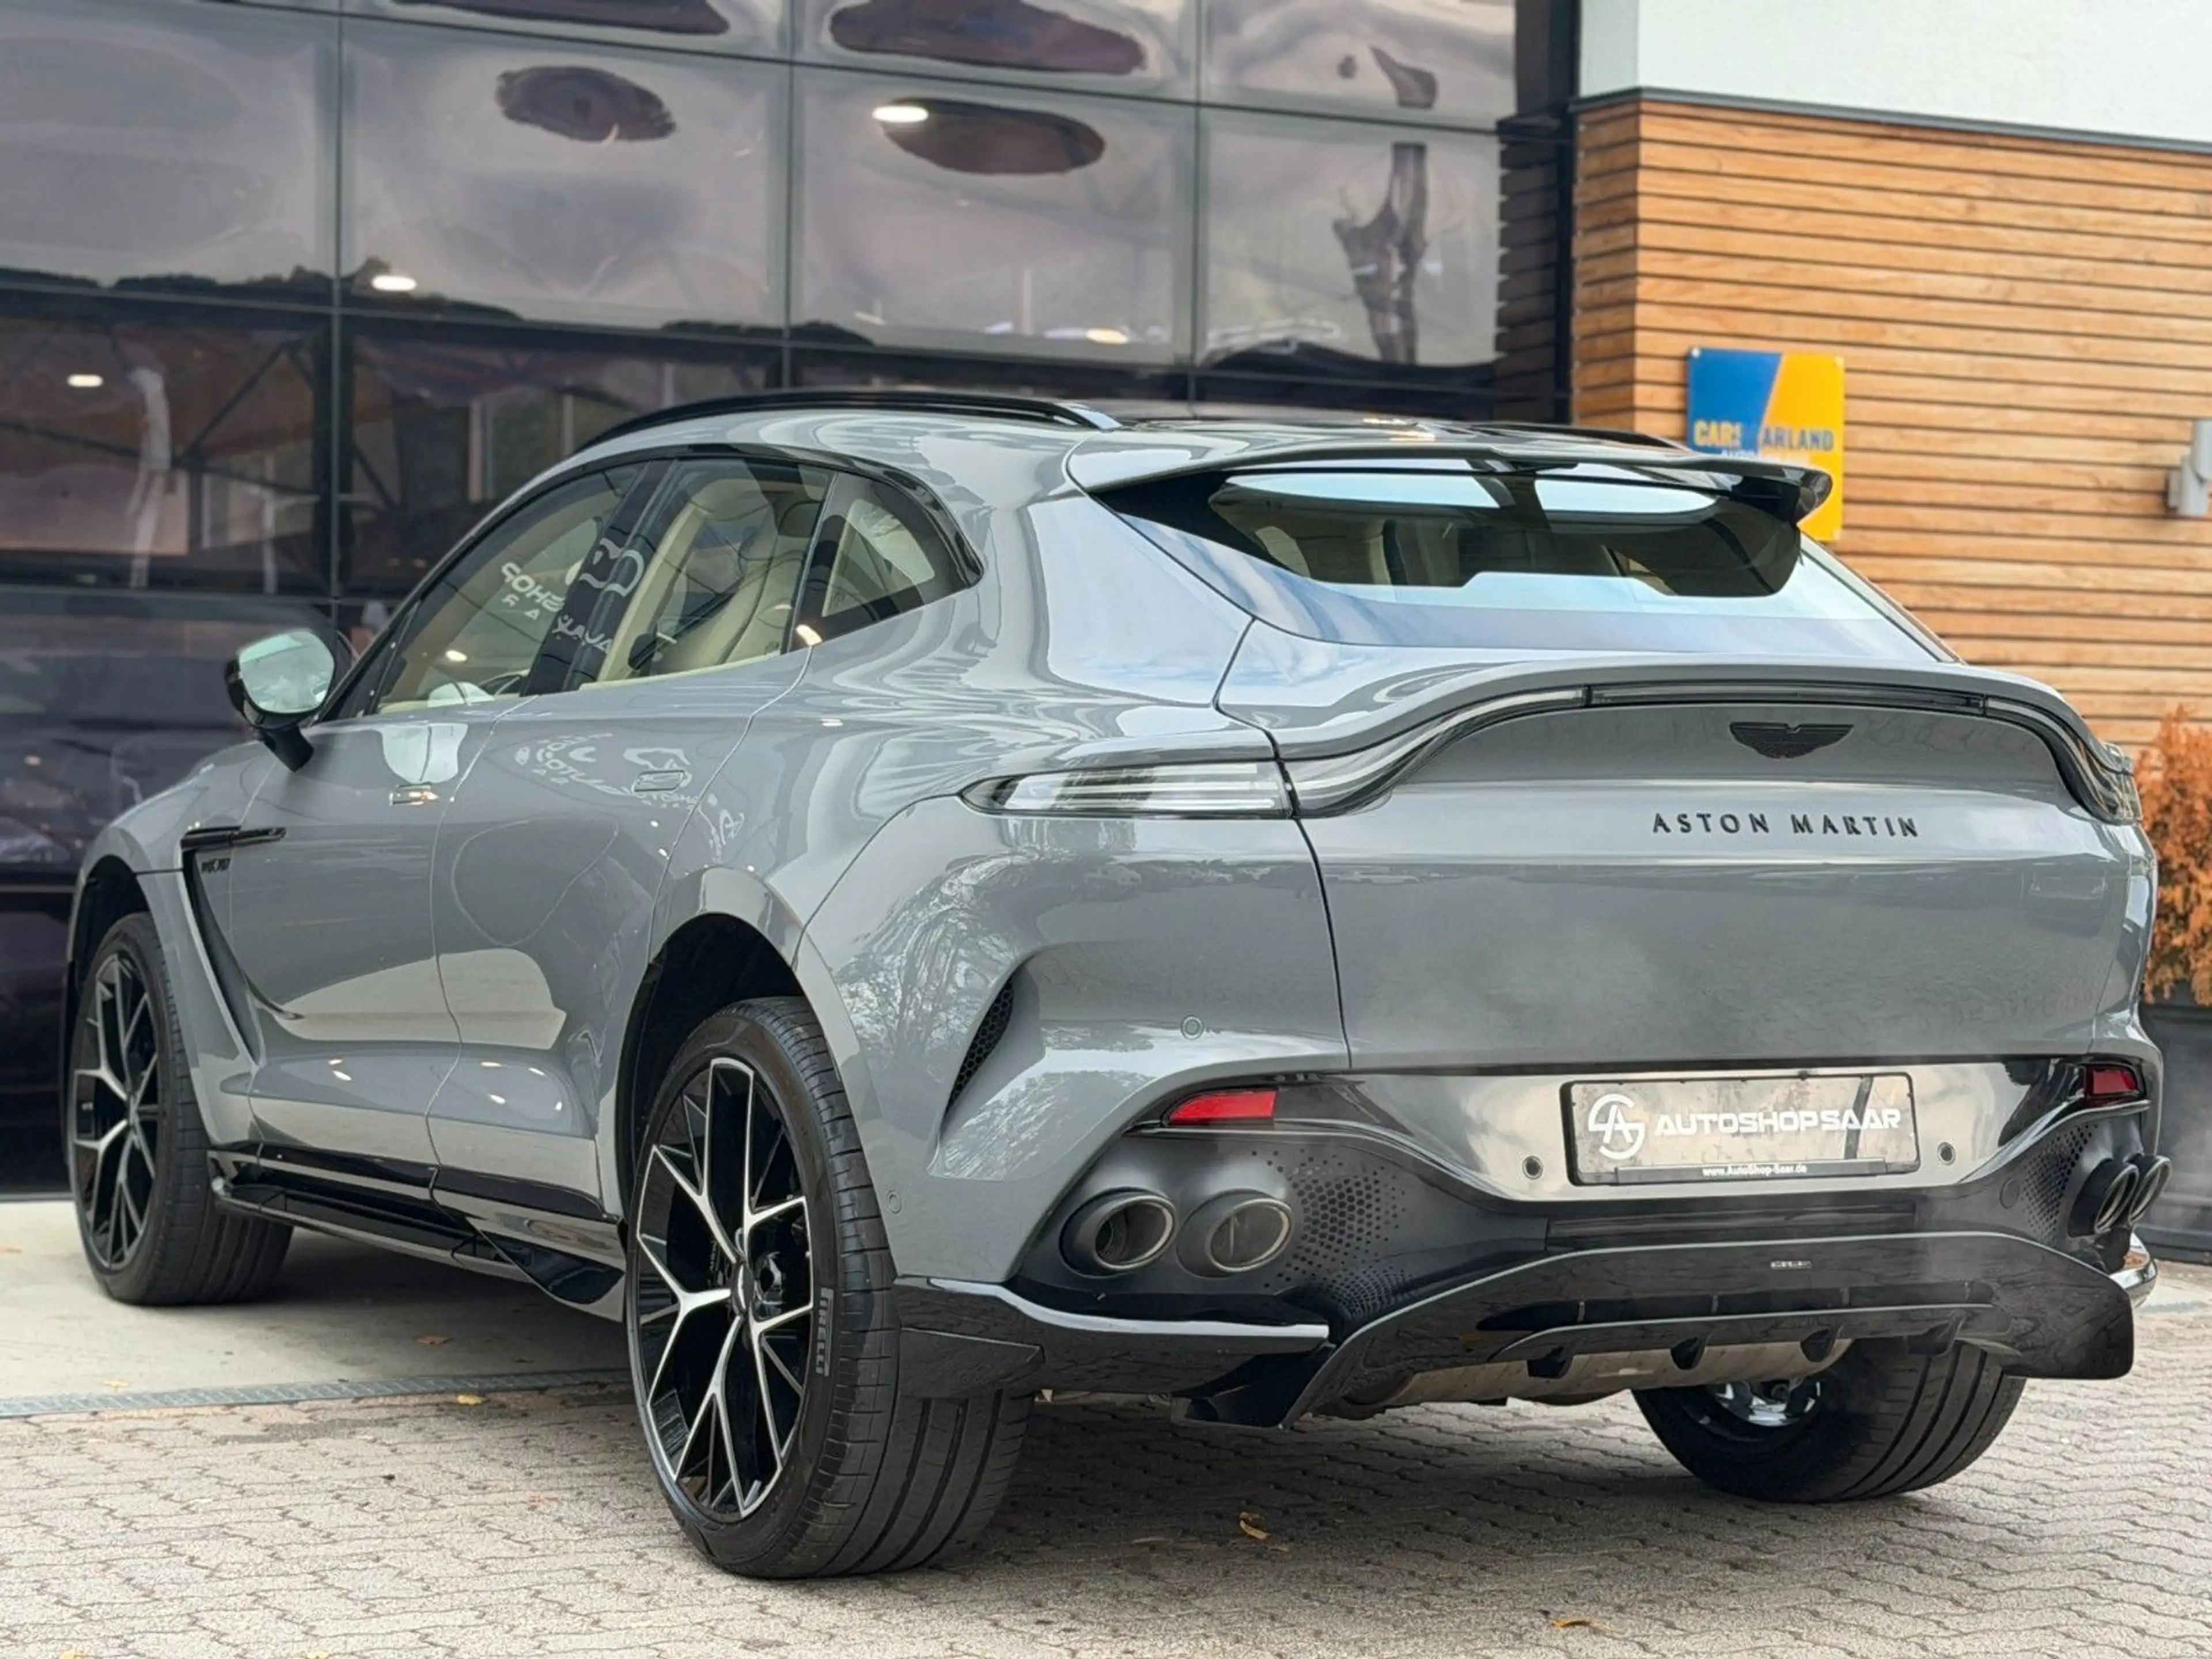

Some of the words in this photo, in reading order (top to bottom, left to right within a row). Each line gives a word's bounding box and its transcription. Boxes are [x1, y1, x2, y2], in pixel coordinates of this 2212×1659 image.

[1653, 813, 1770, 834] ASTON
[1790, 813, 1918, 838] MARTIN
[816, 1287, 835, 1377] PIRELLI
